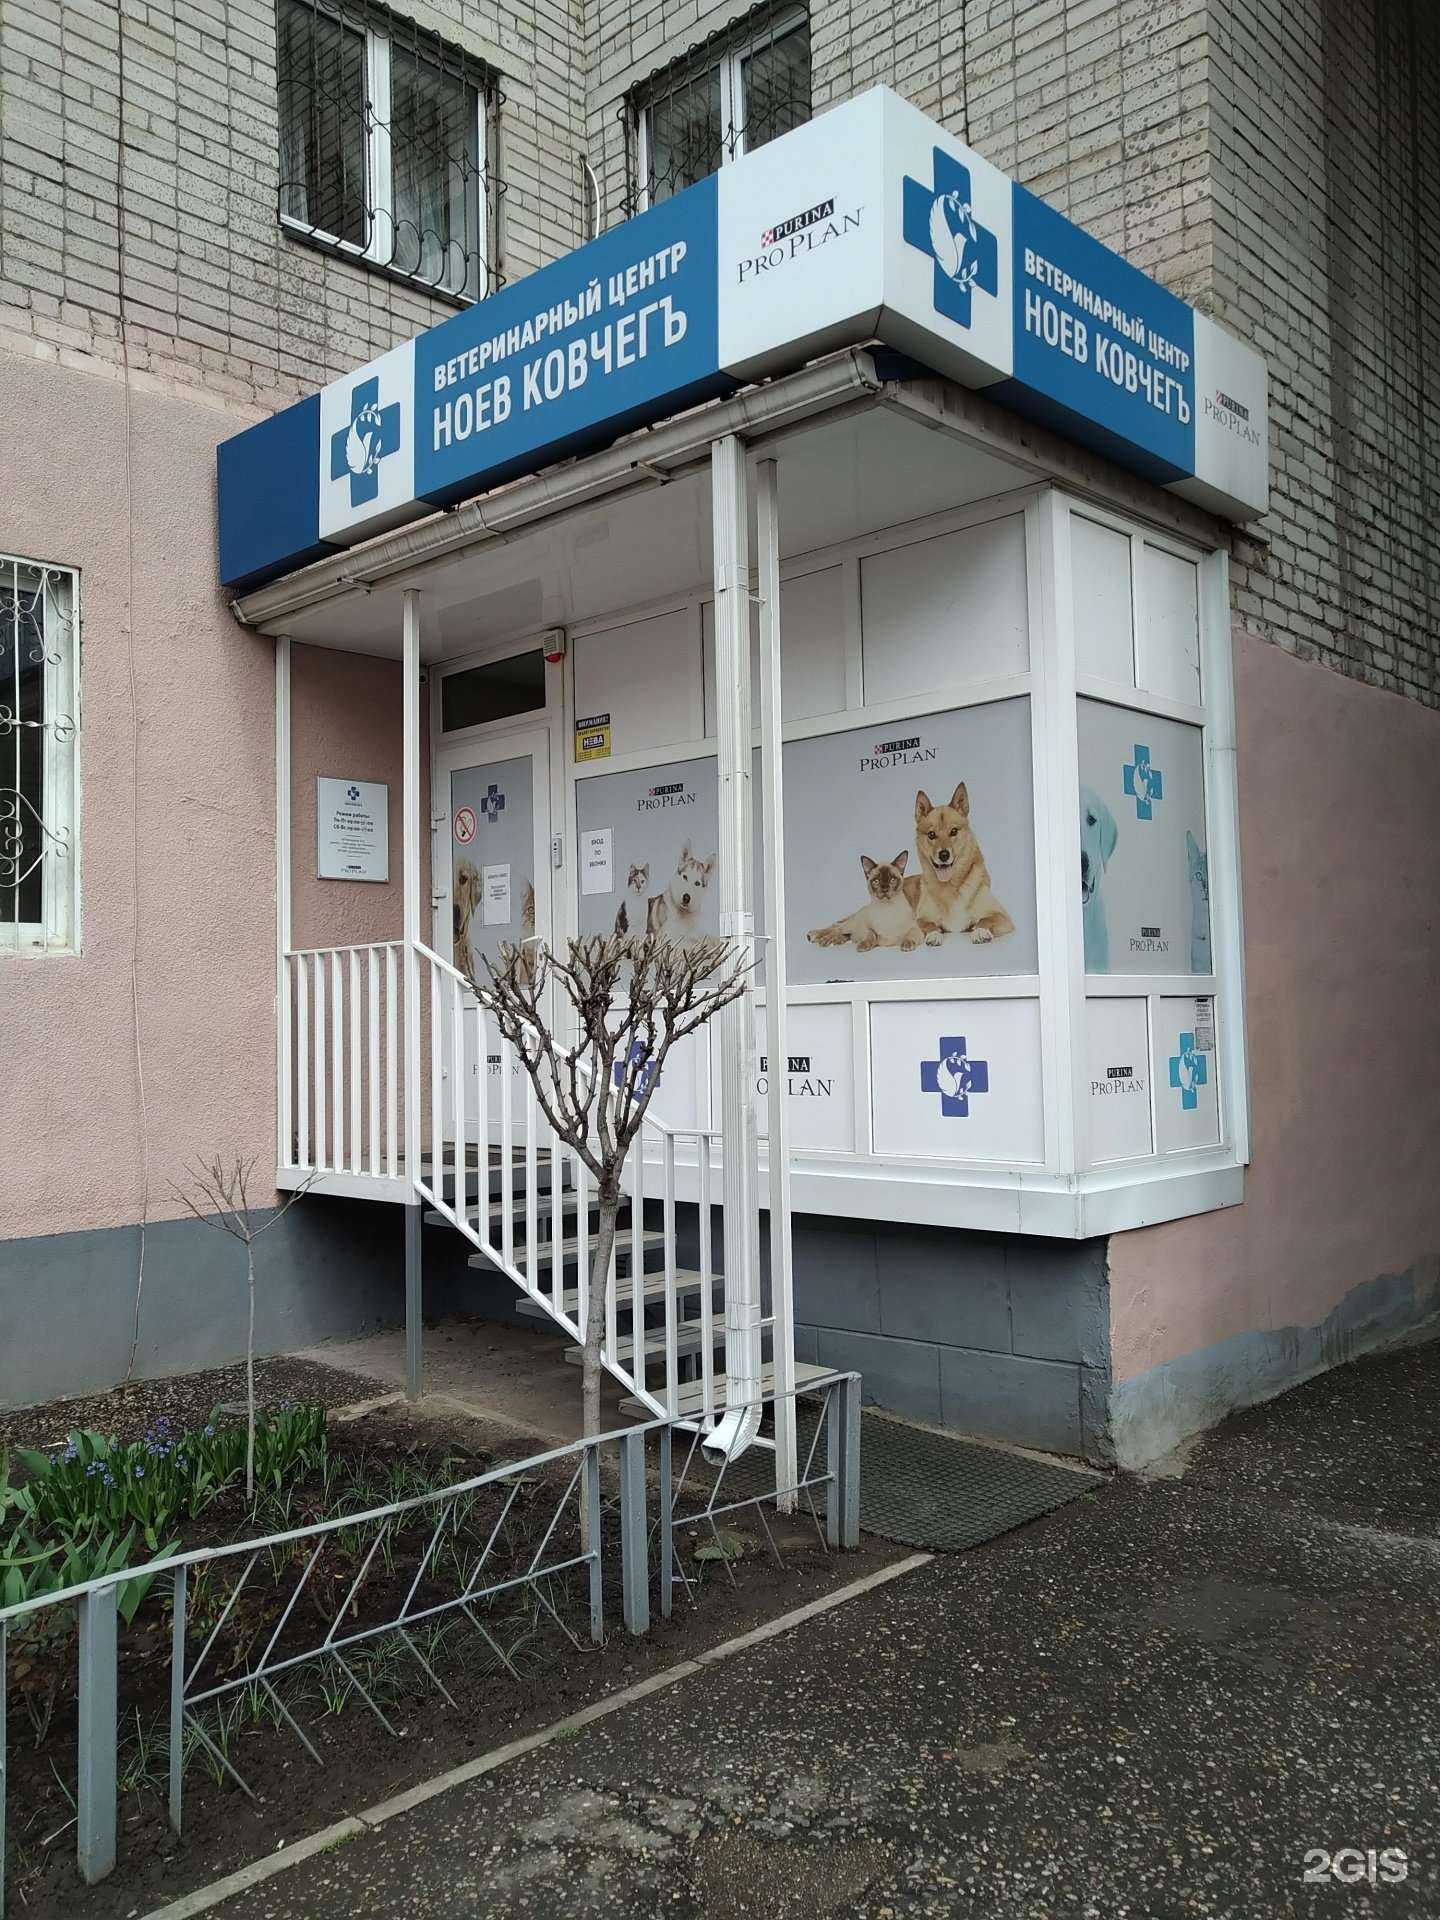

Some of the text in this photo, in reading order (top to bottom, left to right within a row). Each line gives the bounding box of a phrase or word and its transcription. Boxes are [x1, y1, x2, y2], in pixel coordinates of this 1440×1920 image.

[774, 200, 832, 241] PURINA
[434, 240, 687, 392] ВЕТЕРИНАРНЫЙ ЦЕНТР
[1025, 248, 1190, 373] ВЕТЕРИНАРНЫЙ ЦЕНТР
[433, 295, 688, 451] НОЕВ КОВЧЕГЪ
[1025, 288, 1190, 424] НОЕВ КОВЧЕГЪ
[883, 737, 920, 753] PURINA
[654, 783, 684, 796] PURINA
[1107, 1067, 1132, 1078] PURINA
